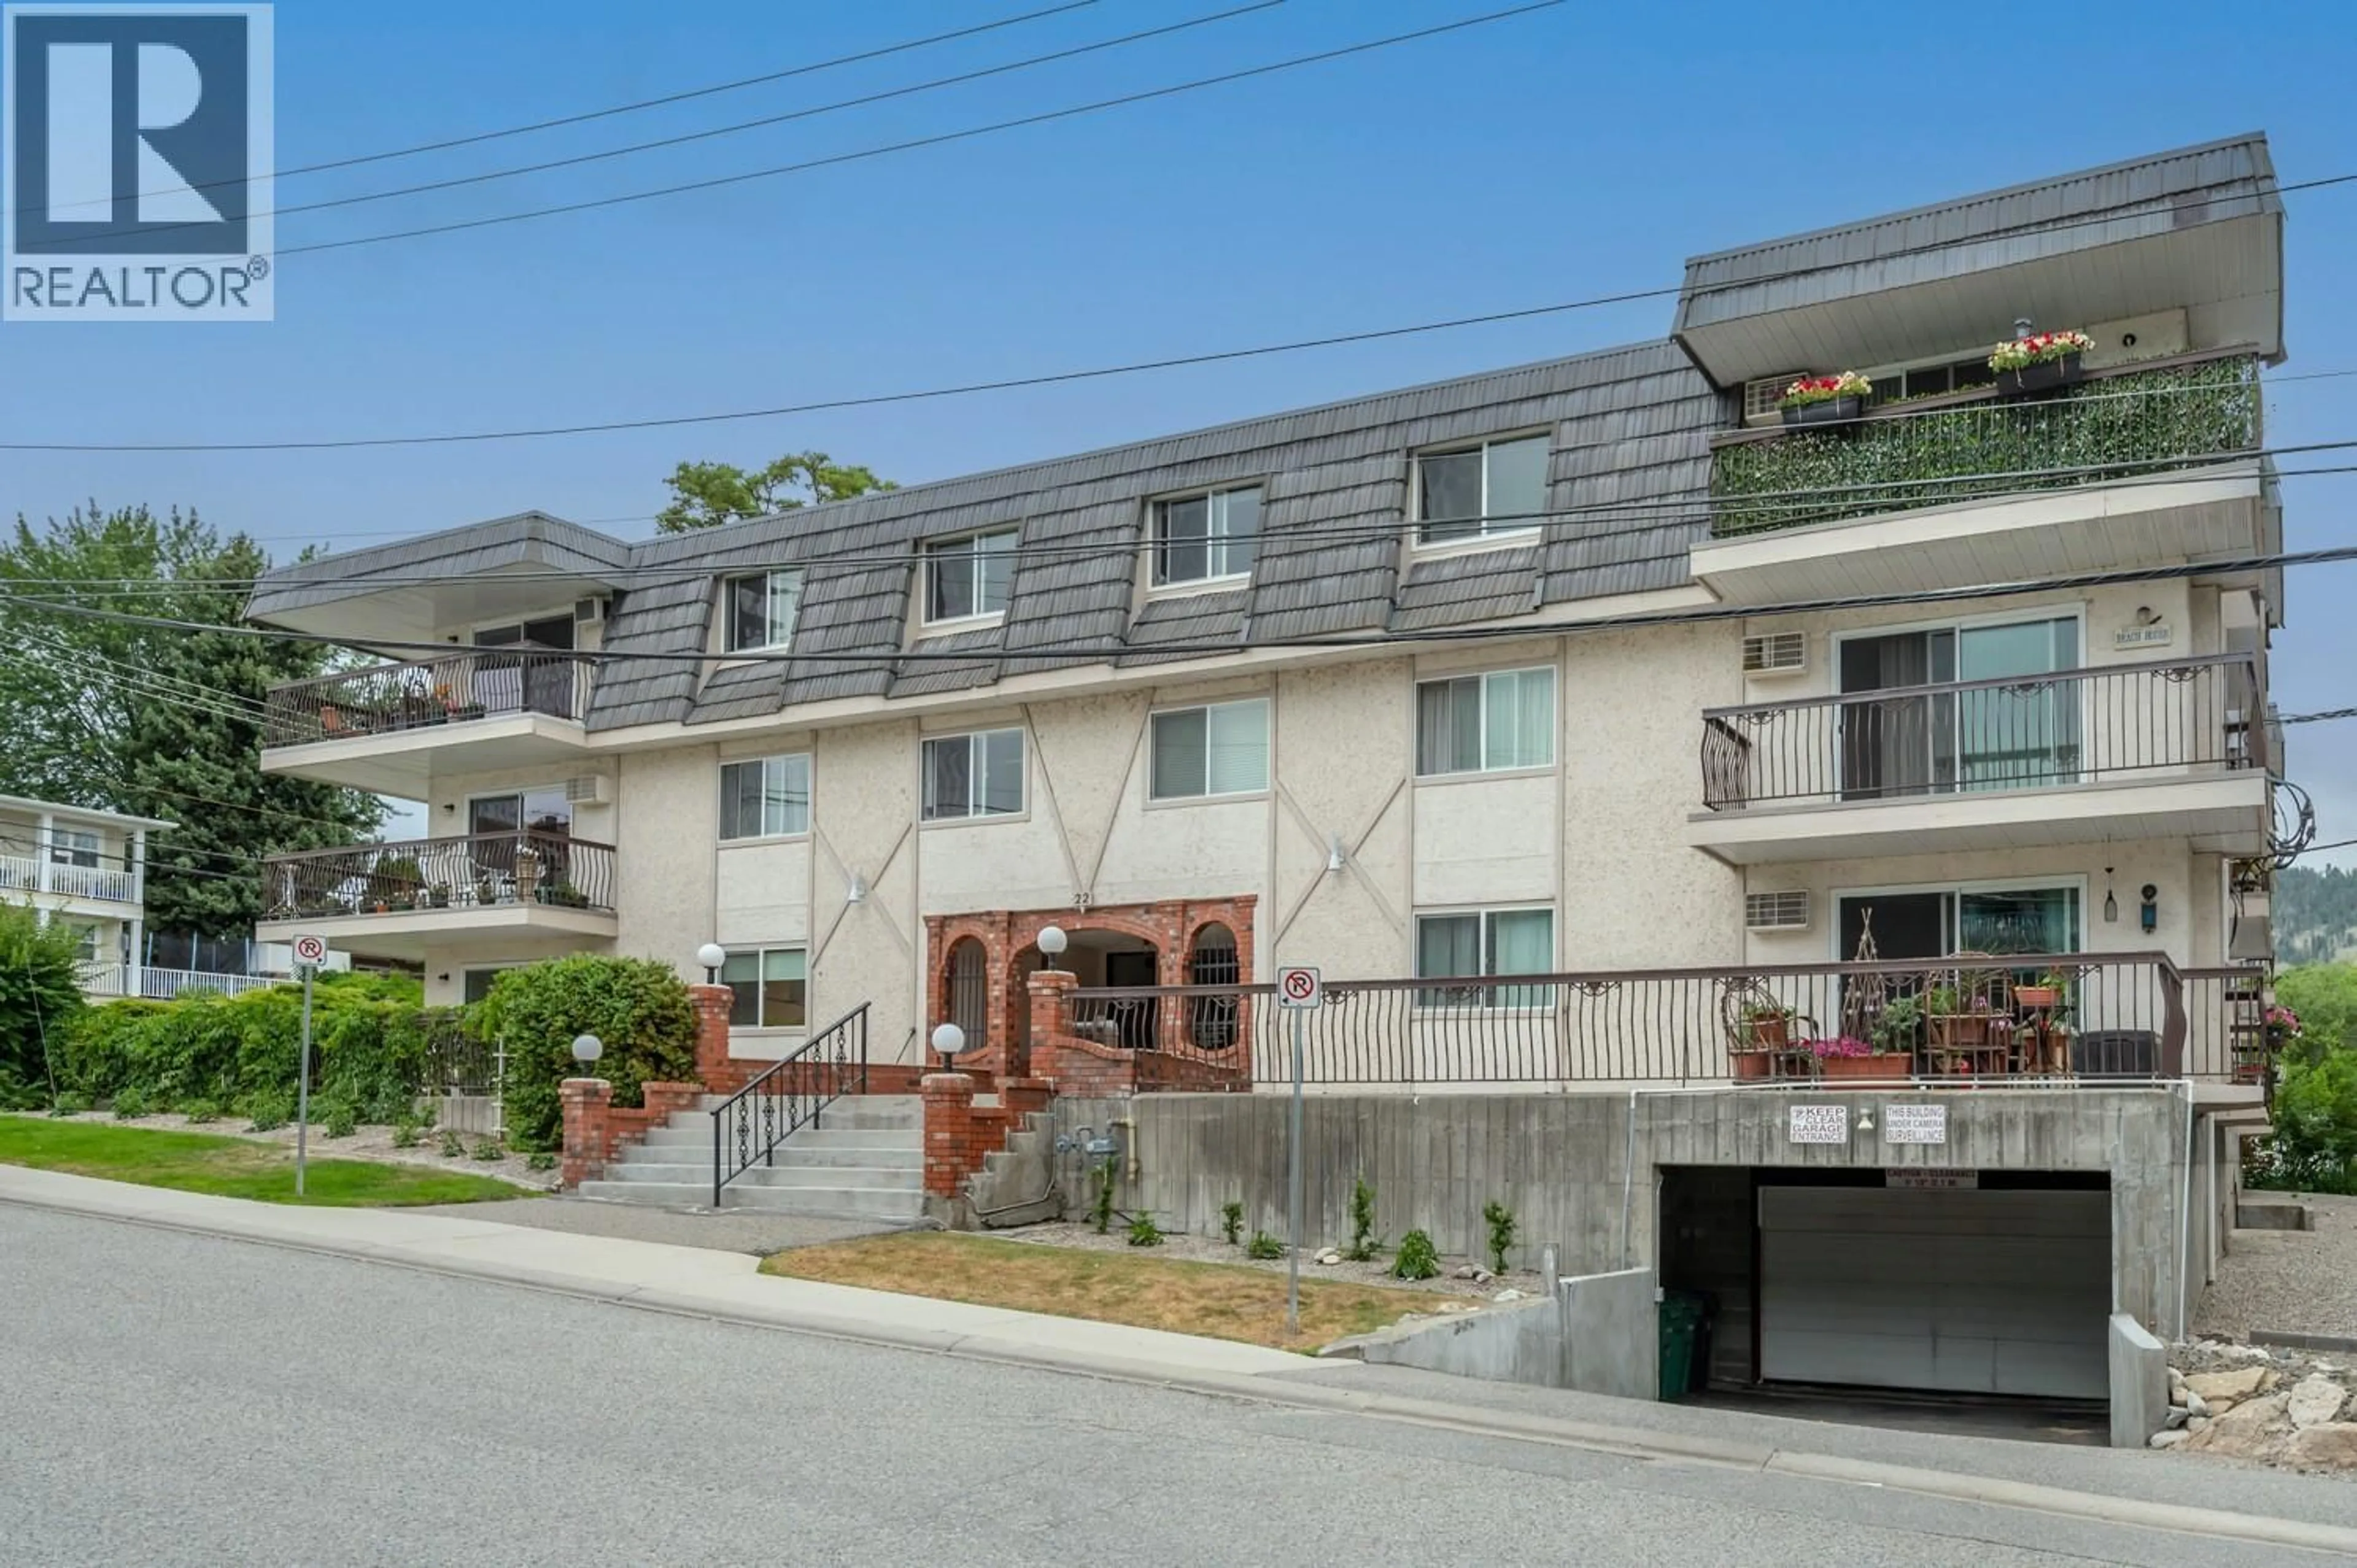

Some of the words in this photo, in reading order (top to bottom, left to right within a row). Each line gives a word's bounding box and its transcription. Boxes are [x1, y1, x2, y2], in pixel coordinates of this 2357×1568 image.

[1075, 892, 1089, 905] 22
[1806, 1107, 1844, 1116] KEEP
[1887, 1107, 1904, 1117] THIS
[1906, 1107, 1943, 1117] BUILDING
[1887, 1119, 1911, 1128] UNDER
[1913, 1119, 1943, 1128] CAMERA
[1792, 1132, 1844, 1141] ENTRANCE
[1887, 1130, 1943, 1141] SURVEILLANCE
